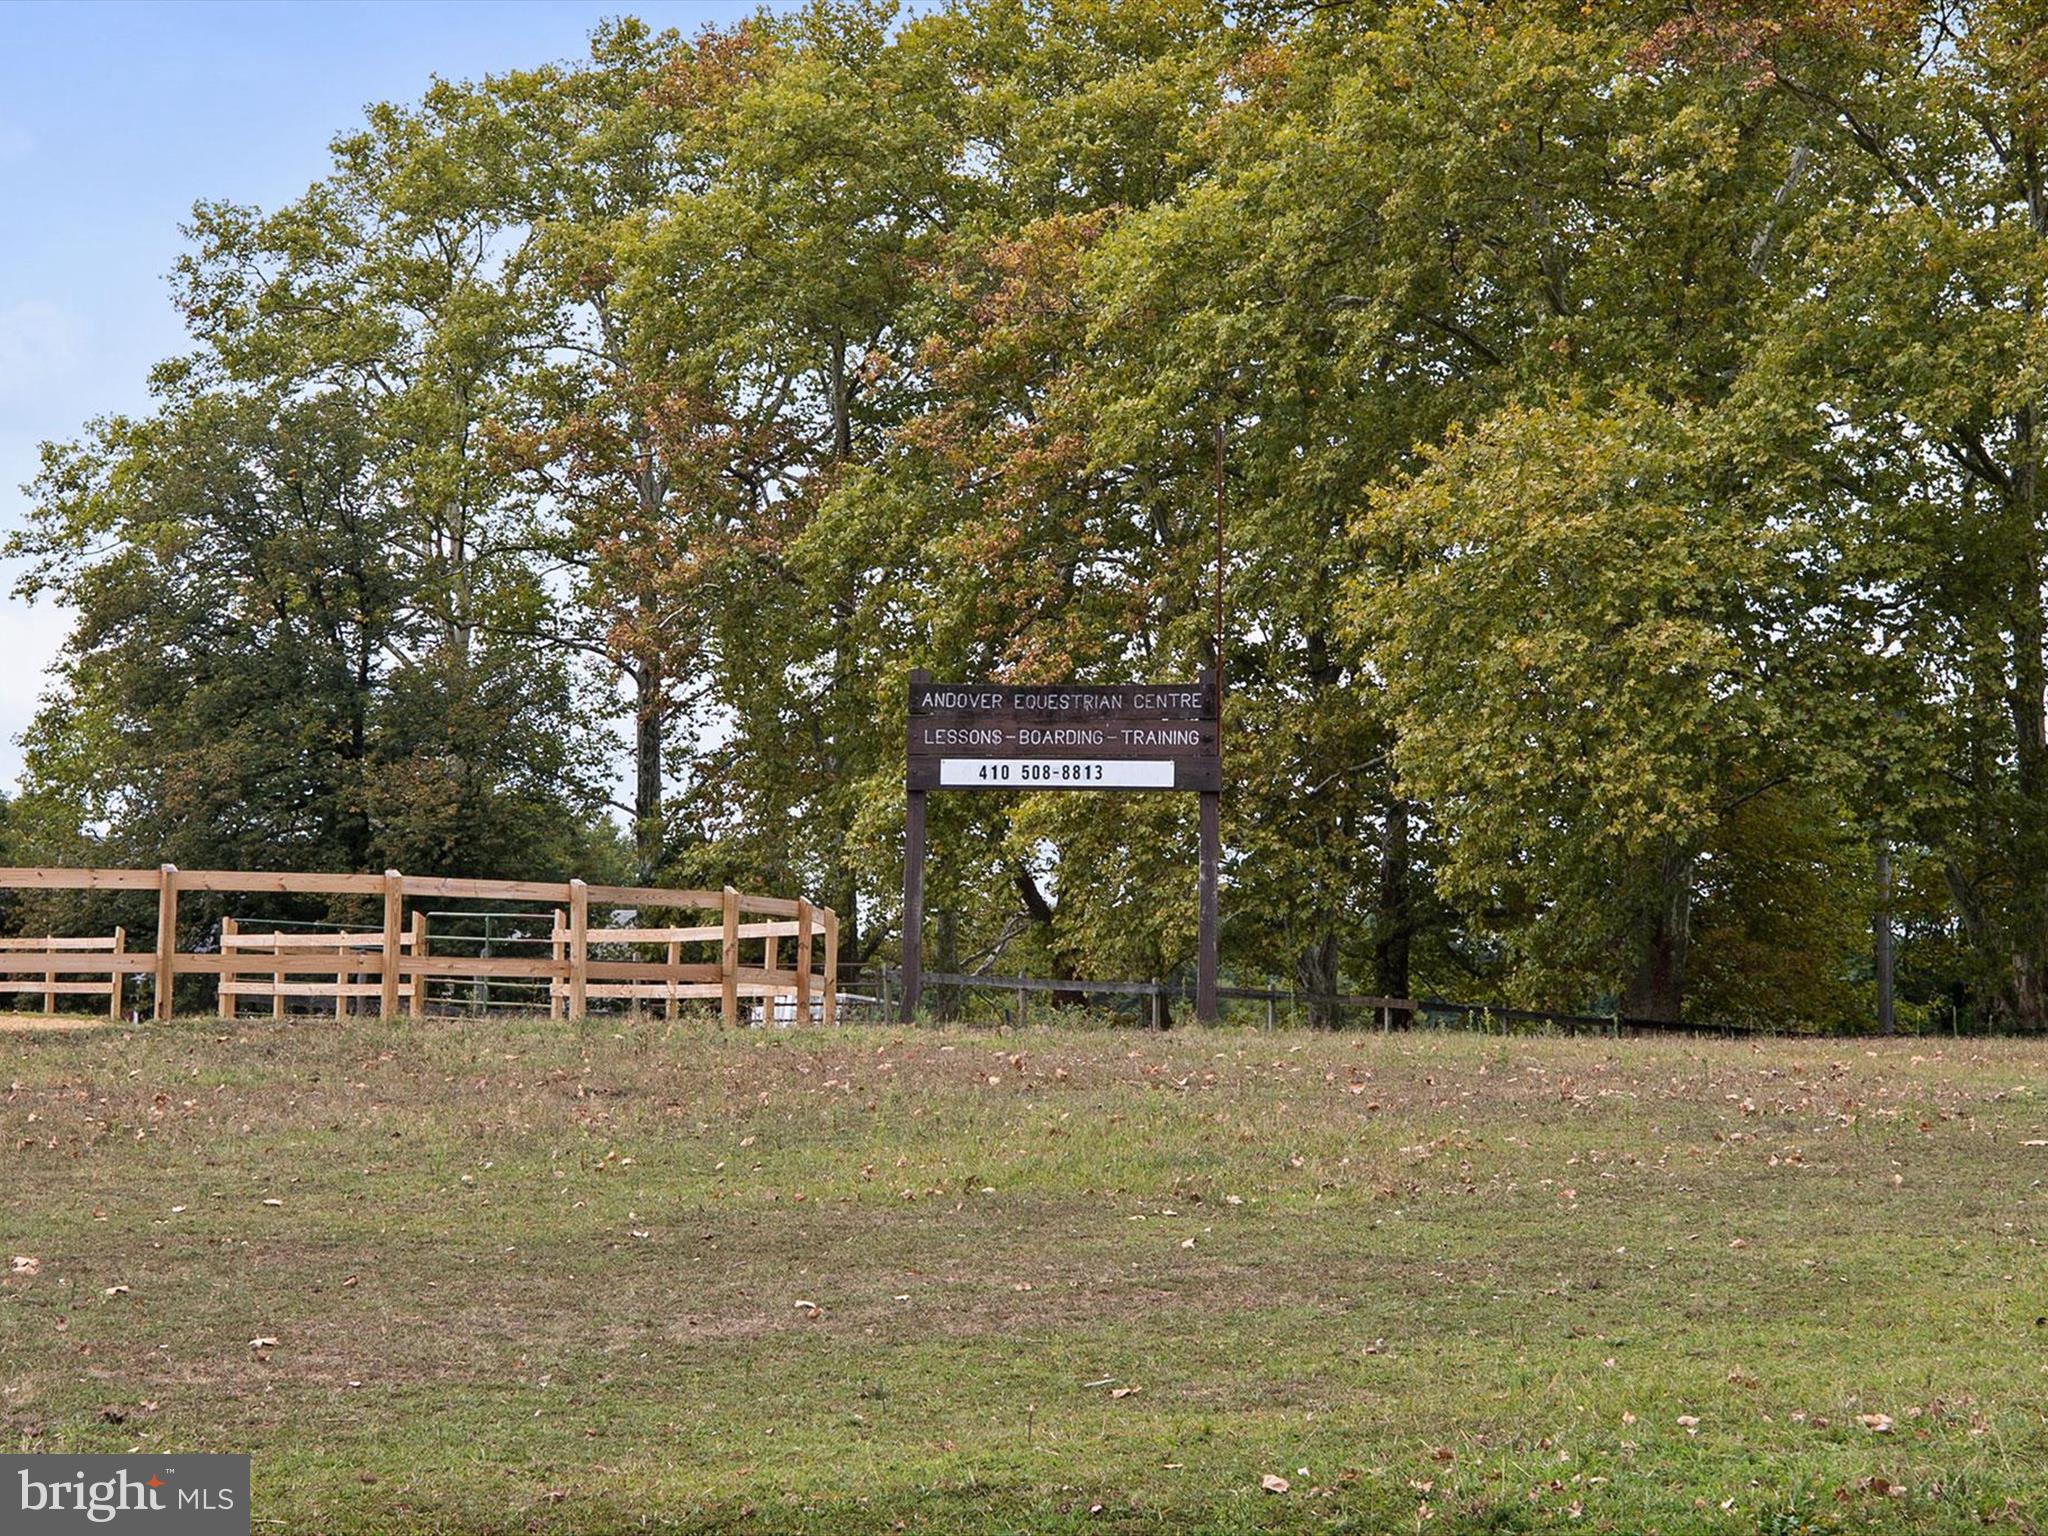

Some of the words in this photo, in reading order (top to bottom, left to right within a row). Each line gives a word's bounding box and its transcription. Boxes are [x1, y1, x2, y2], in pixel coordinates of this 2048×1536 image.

[921, 692, 1003, 710] ANDOVER
[1014, 693, 1123, 711] EQUESTRIAN
[1133, 692, 1202, 710] CENTRE
[979, 764, 1010, 780] 410
[1021, 764, 1103, 780] 508-8813
